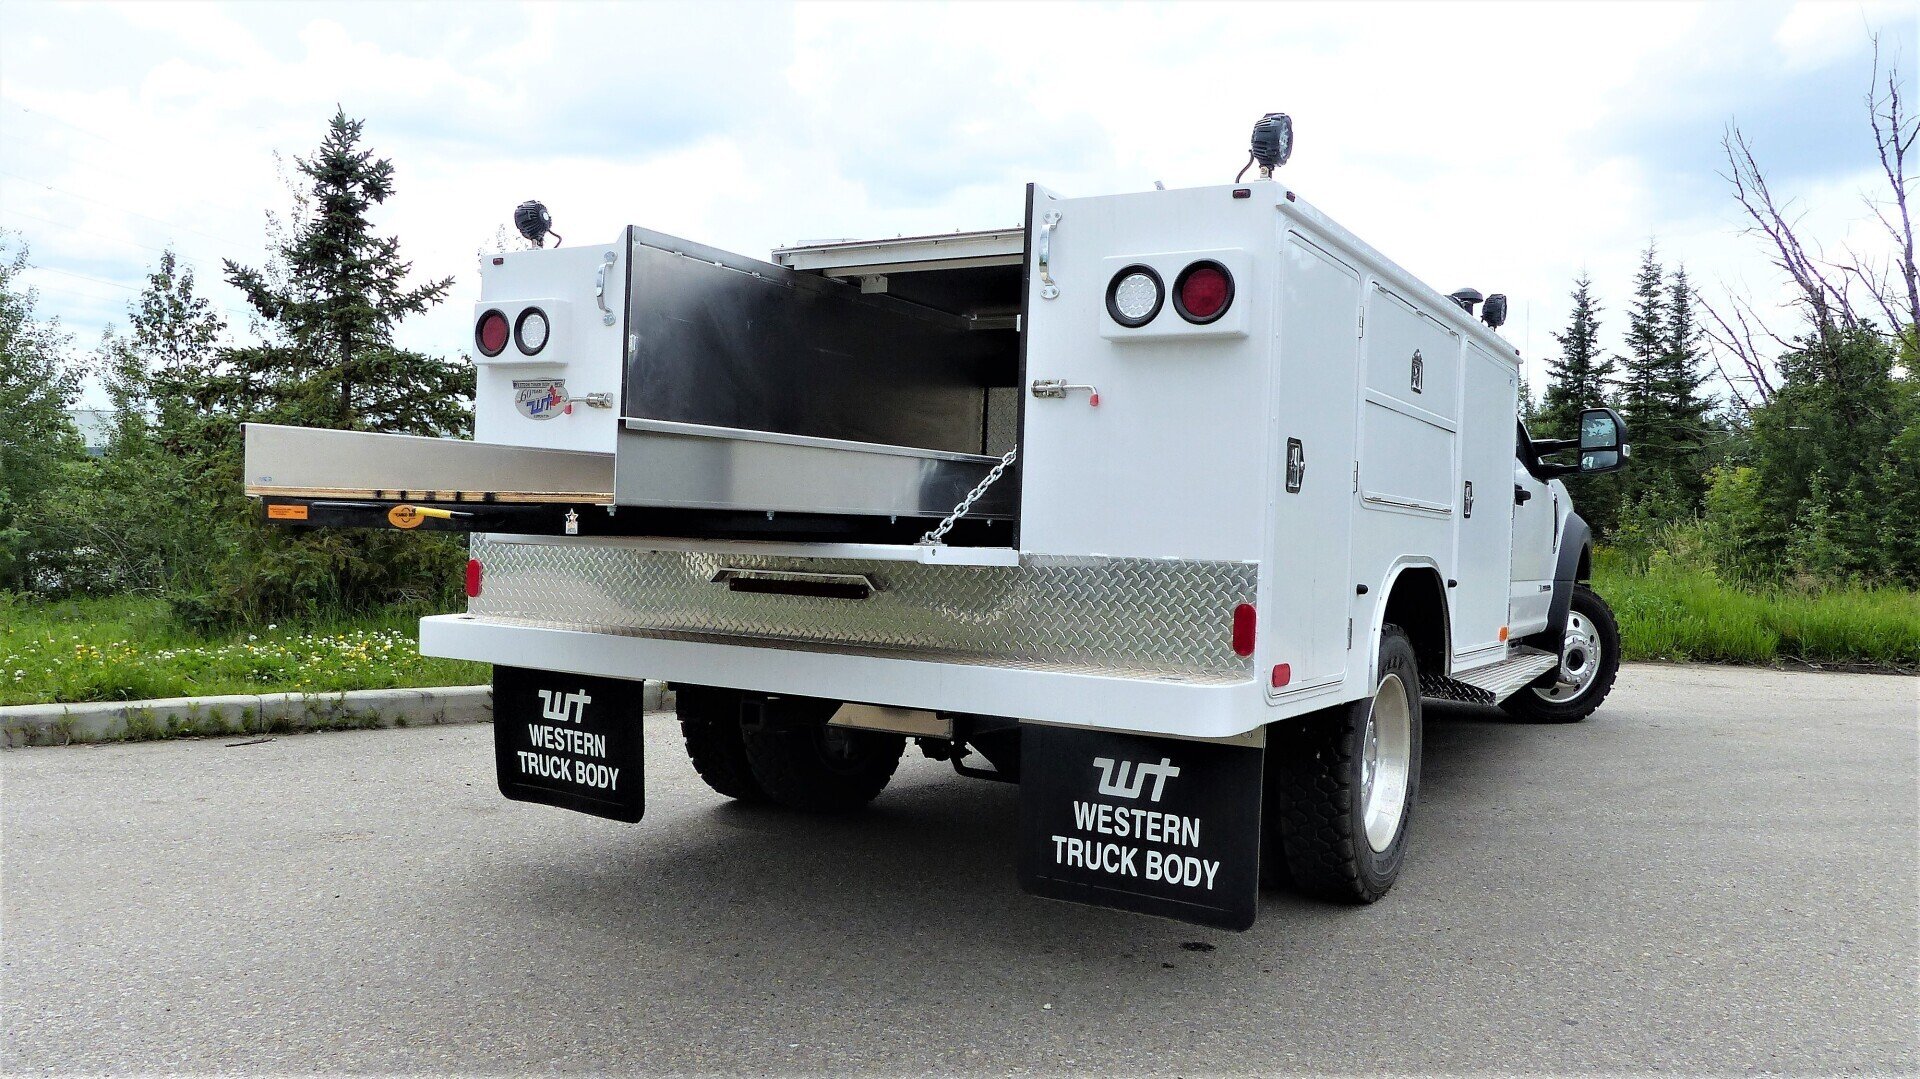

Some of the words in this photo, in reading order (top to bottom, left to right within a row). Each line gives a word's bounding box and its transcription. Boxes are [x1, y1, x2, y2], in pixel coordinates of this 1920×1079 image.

[529, 724, 605, 758] WESTERN
[518, 751, 572, 781] TRUCK
[576, 761, 619, 790] BODY
[1074, 801, 1199, 847] WESTERN
[1052, 836, 1138, 876] TRUCK
[1146, 850, 1219, 890] BODY
